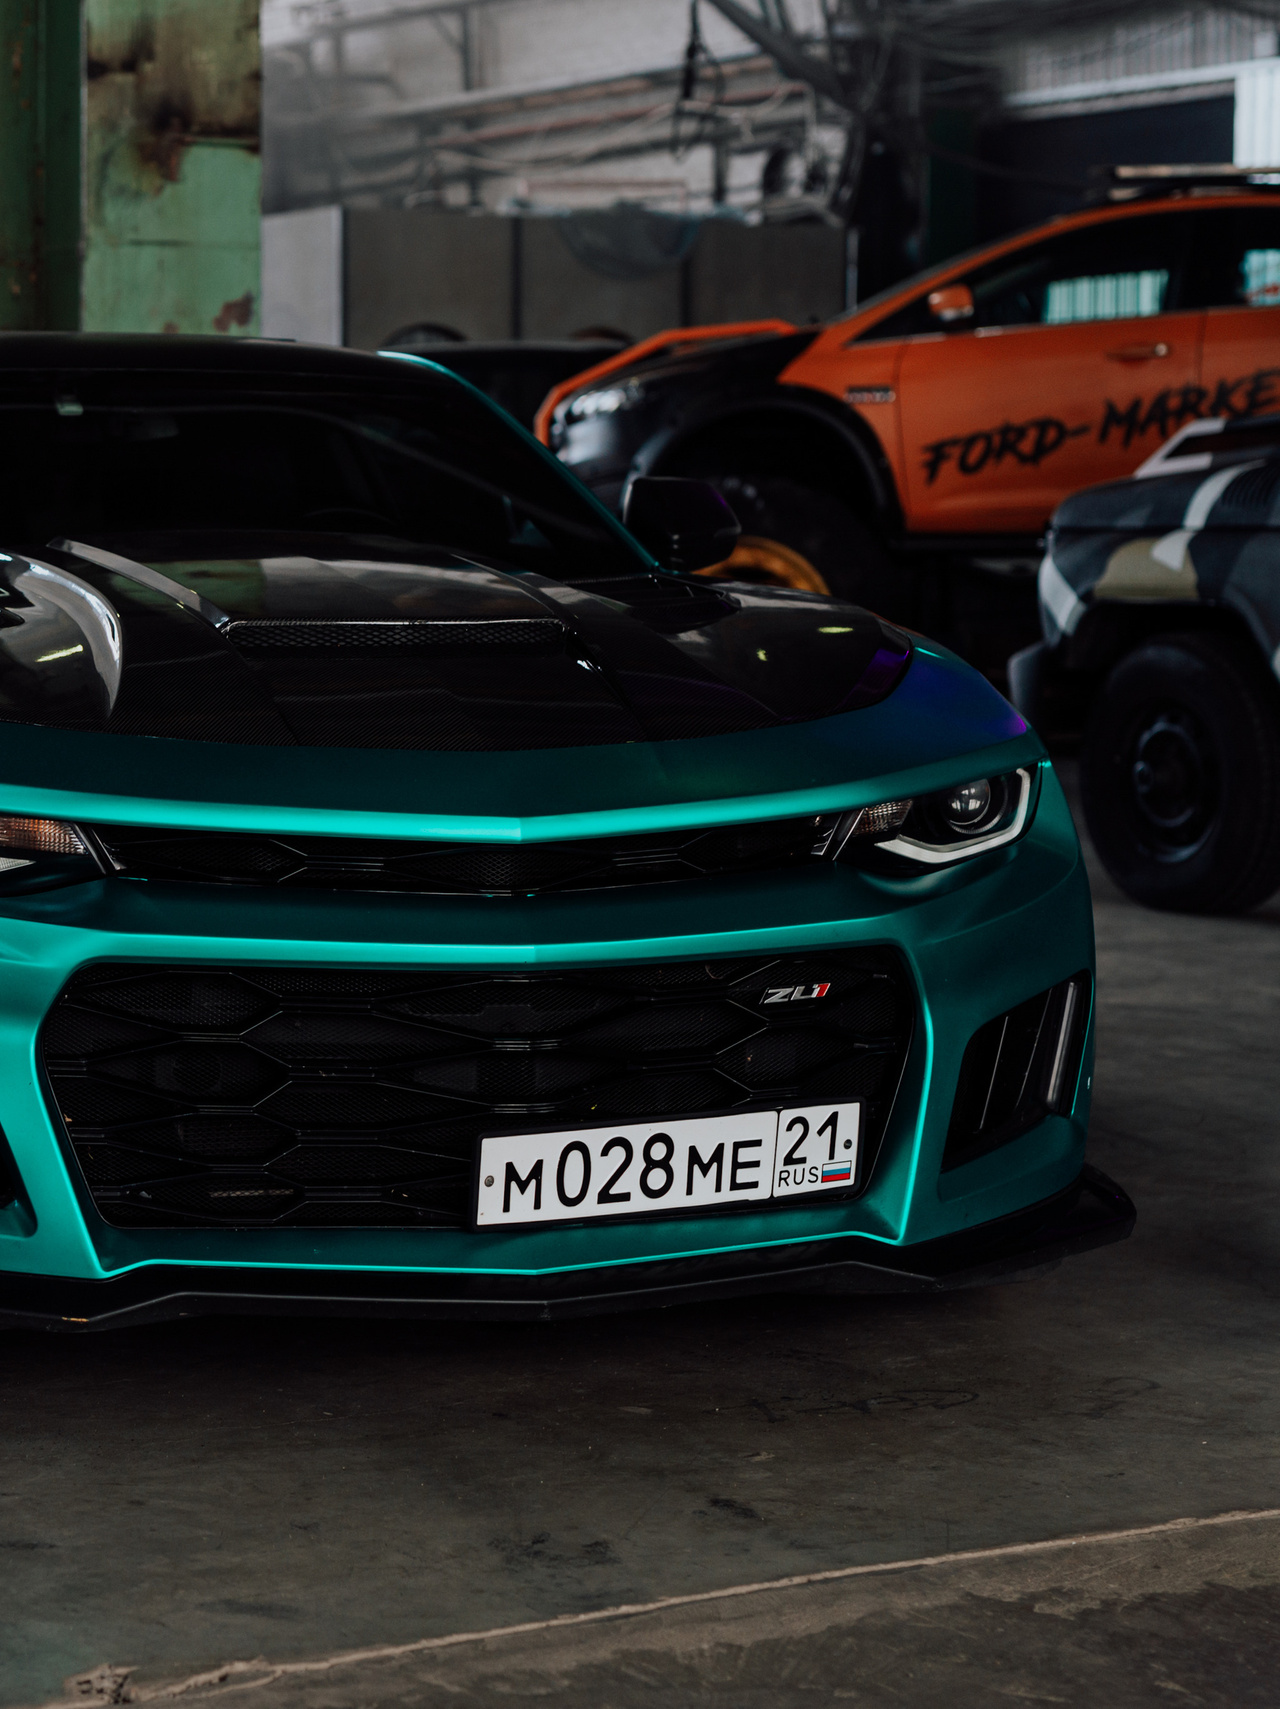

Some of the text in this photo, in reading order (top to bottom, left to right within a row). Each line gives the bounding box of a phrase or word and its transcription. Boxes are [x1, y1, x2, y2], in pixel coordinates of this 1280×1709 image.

[763, 983, 831, 1004] ZL1
[782, 1111, 839, 1166] 21
[777, 1164, 819, 1188] RUS
